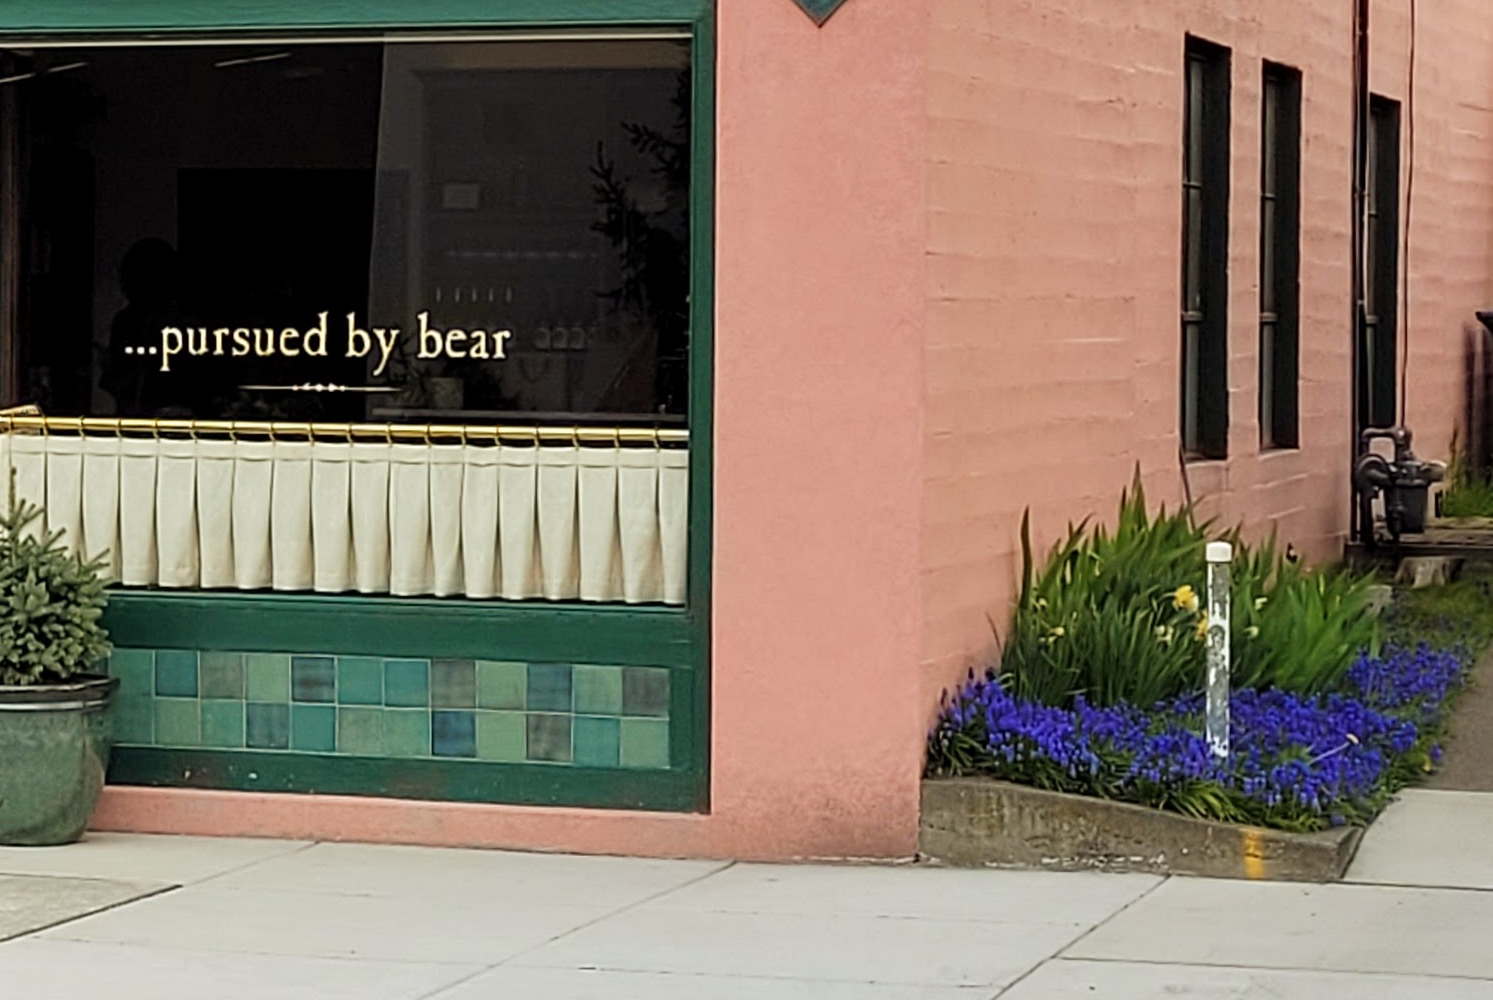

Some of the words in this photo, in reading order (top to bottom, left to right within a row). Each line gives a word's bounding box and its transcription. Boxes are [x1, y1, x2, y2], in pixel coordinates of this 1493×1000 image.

[124, 311, 329, 372] ...pursued
[345, 311, 400, 376] by
[417, 311, 511, 360] bear
